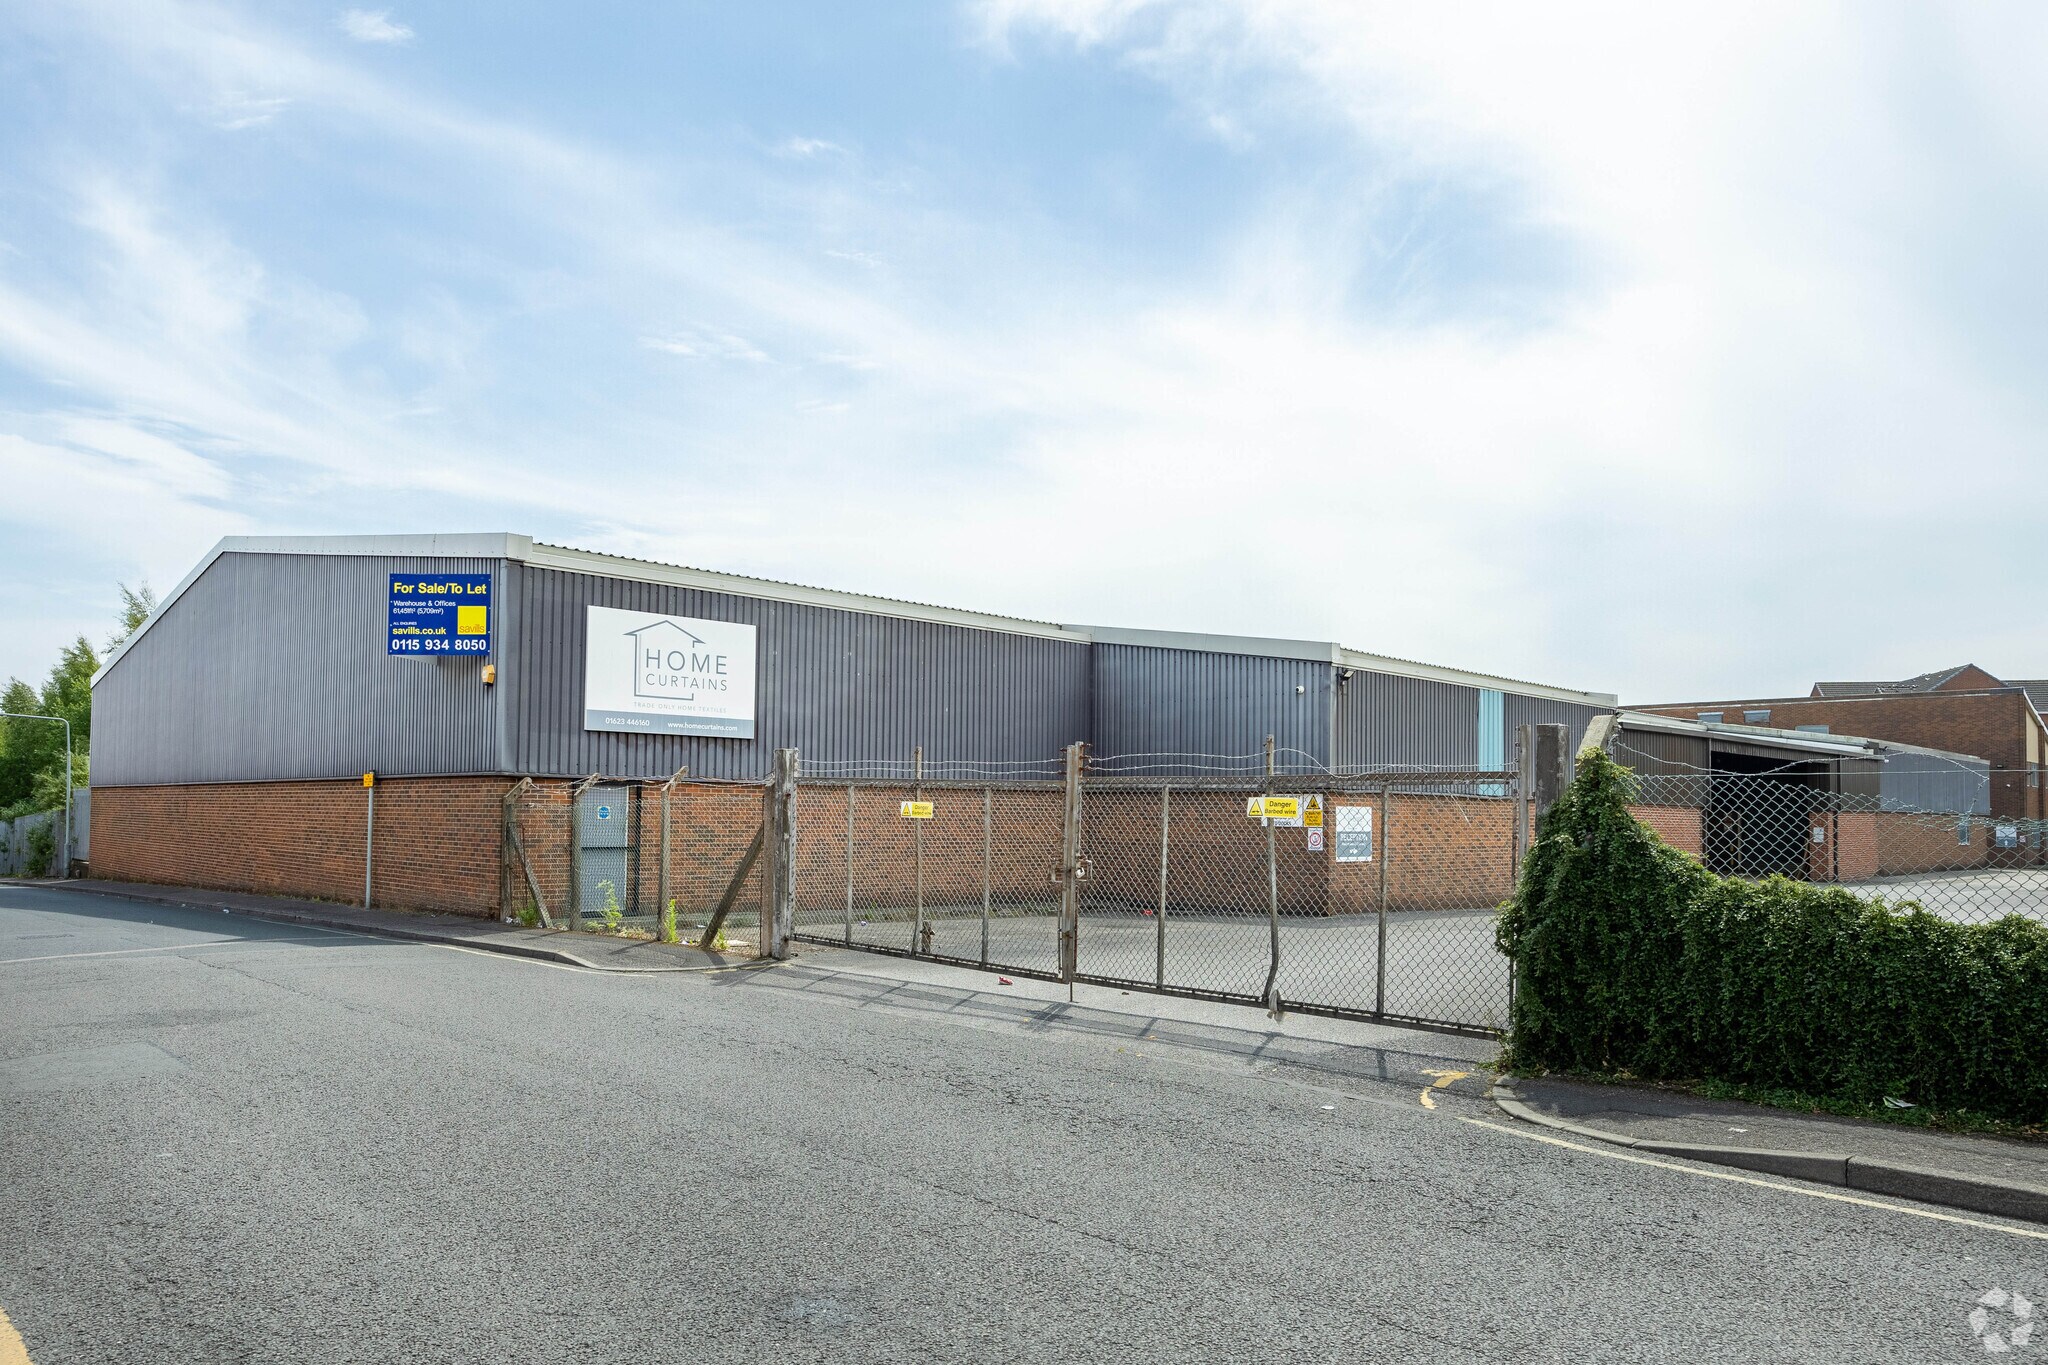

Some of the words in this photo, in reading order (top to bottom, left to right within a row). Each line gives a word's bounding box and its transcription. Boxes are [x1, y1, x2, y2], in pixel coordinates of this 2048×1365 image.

[393, 582, 414, 594] For
[418, 582, 463, 595] Sale/To
[467, 583, 487, 595] Let
[392, 626, 447, 635] savills.co.uk
[459, 624, 485, 633] savills
[392, 639, 419, 650] 0115
[425, 639, 449, 650] 934
[455, 639, 486, 650] 8050
[646, 648, 728, 675] HOME
[645, 673, 728, 692] CURTAINS
[633, 701, 656, 709] TRADE
[657, 702, 676, 710] ONLY
[677, 704, 696, 712] HOME
[605, 717, 625, 725] 01623
[626, 718, 650, 727] 446160
[667, 721, 738, 732] www.homecurtains.com
[1269, 800, 1292, 808] Danger
